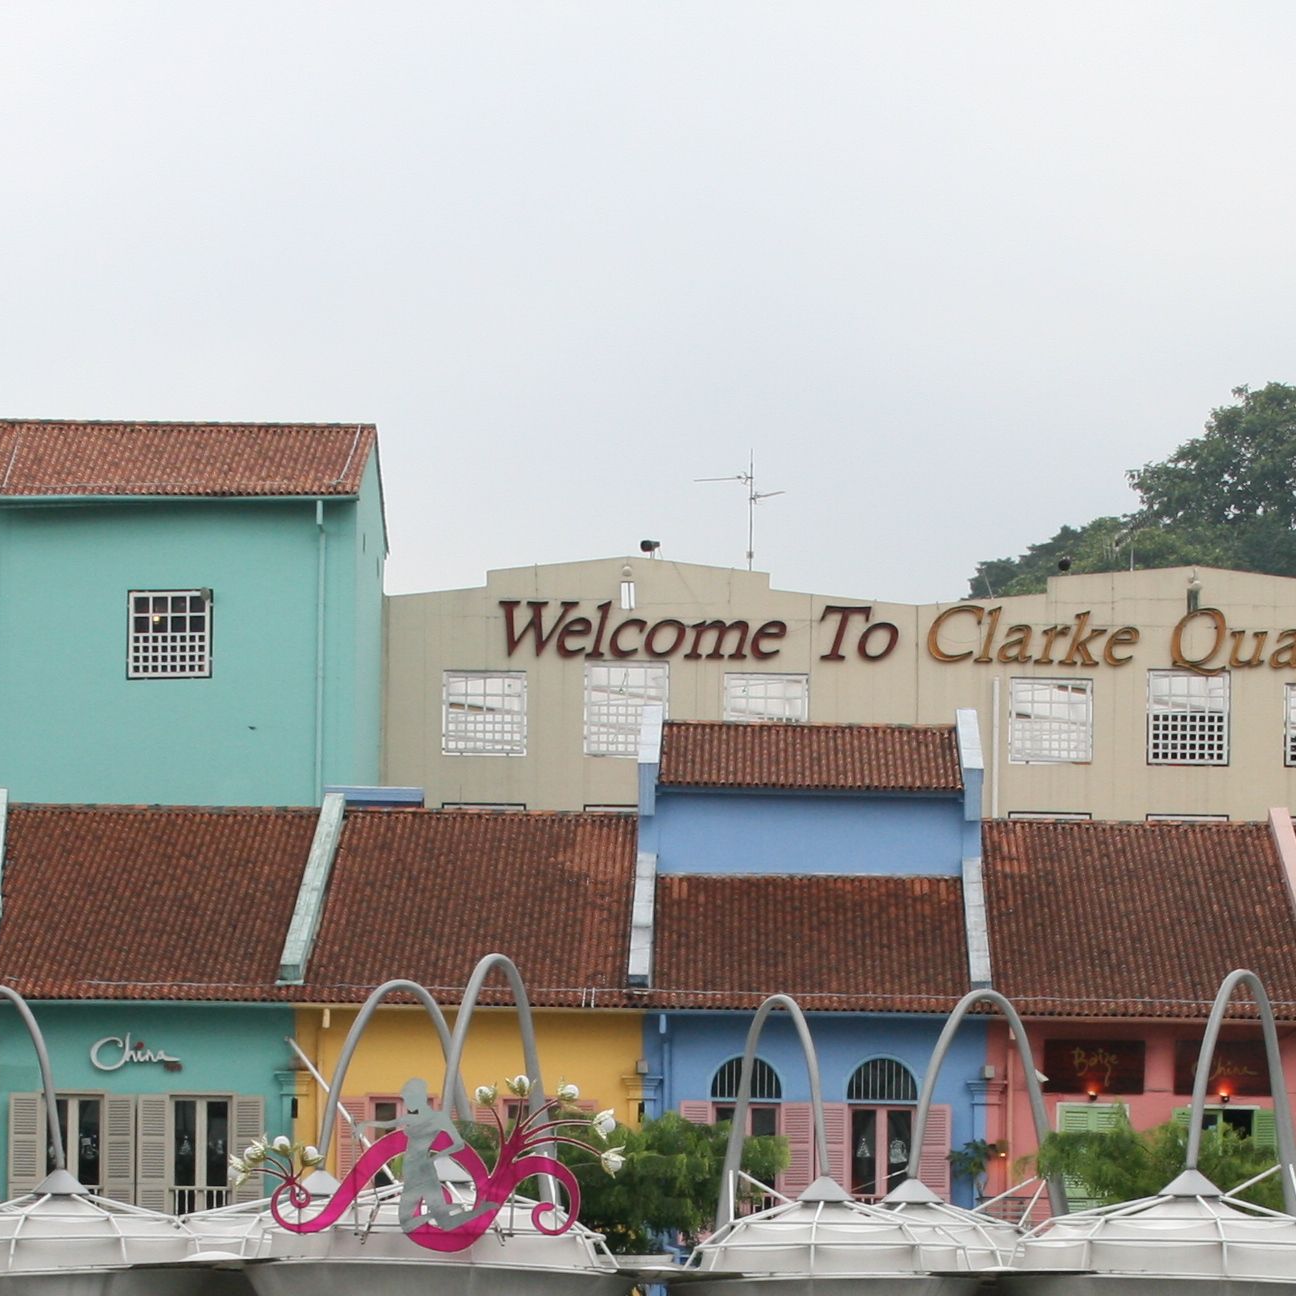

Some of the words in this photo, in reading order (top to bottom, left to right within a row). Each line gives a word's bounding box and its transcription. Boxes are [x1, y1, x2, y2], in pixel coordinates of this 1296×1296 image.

[499, 600, 787, 661] Welcome
[819, 605, 900, 662] To
[927, 605, 1140, 667] Clarke
[90, 1032, 182, 1071] China
